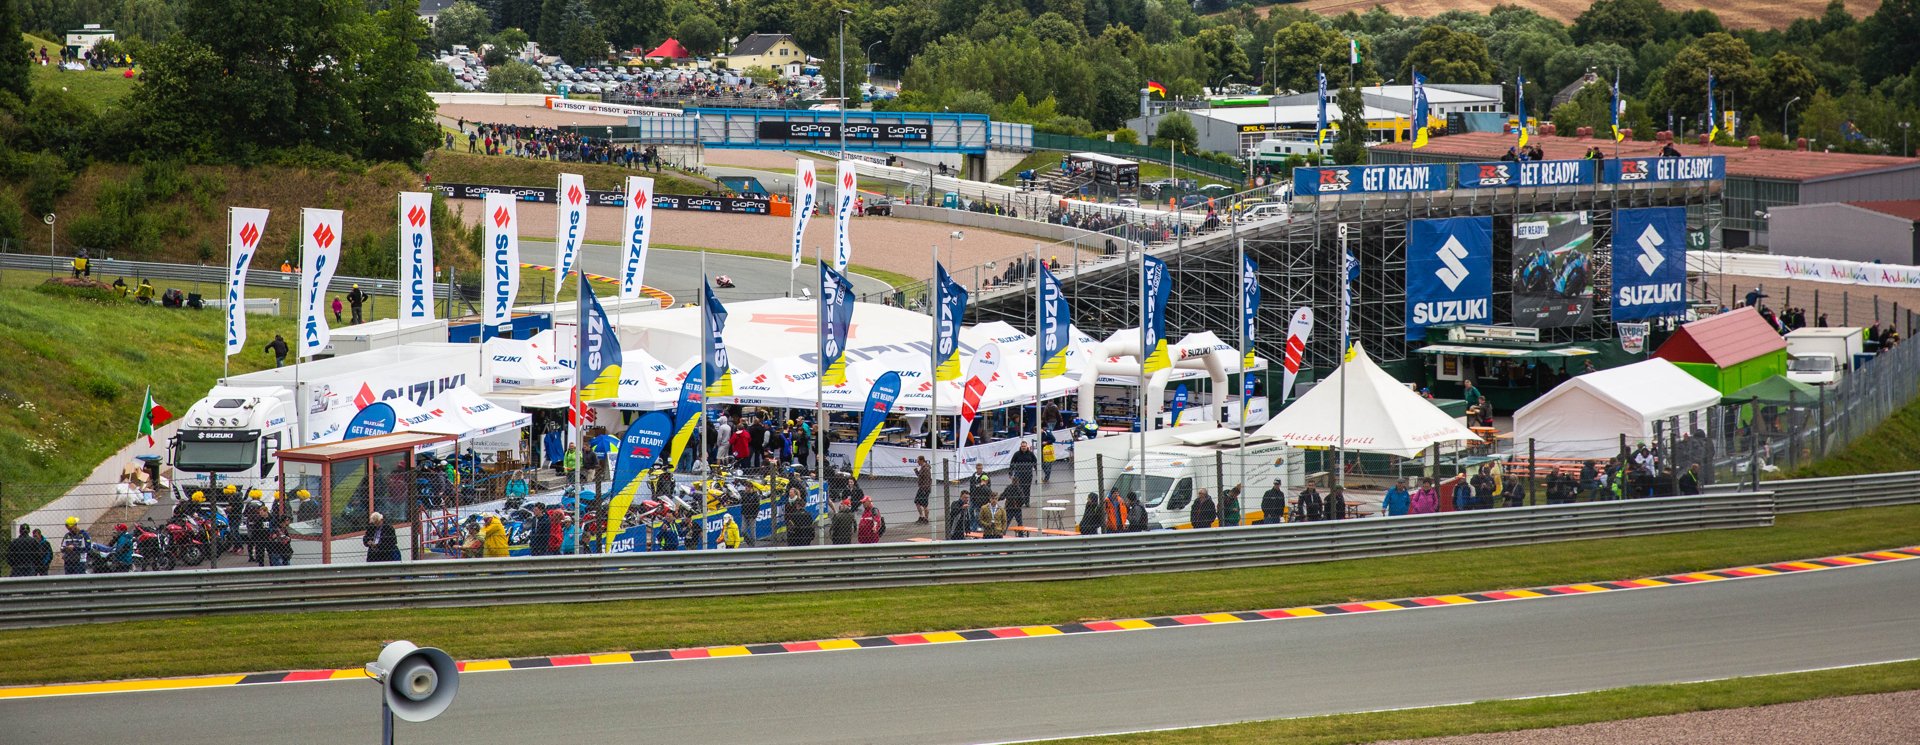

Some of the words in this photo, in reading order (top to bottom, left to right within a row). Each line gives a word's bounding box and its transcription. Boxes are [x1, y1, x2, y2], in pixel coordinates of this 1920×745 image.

[791, 124, 831, 132] GoPro
[1520, 163, 1540, 186] GET
[1541, 161, 1580, 185] READY!
[1657, 158, 1676, 180] GET
[1677, 158, 1713, 179] READY!
[1362, 167, 1386, 192] GET
[1388, 166, 1429, 191] READY!
[1318, 183, 1351, 192] GSX
[651, 196, 679, 204] oPro
[688, 198, 722, 206] GoPro
[731, 201, 765, 209] GoPro
[1690, 231, 1705, 247] T3
[625, 214, 644, 293] SUZUKI
[411, 232, 425, 318] SUZUKI
[495, 233, 510, 319] SUZUKI
[1620, 283, 1682, 307] SUZUKI
[1413, 298, 1487, 324] SUZUKI
[1187, 346, 1211, 358] SUZUKI
[352, 426, 363, 435] GET
[639, 429, 661, 437] SUZUKI
[628, 435, 640, 444] GET
[641, 437, 664, 448] READY!
